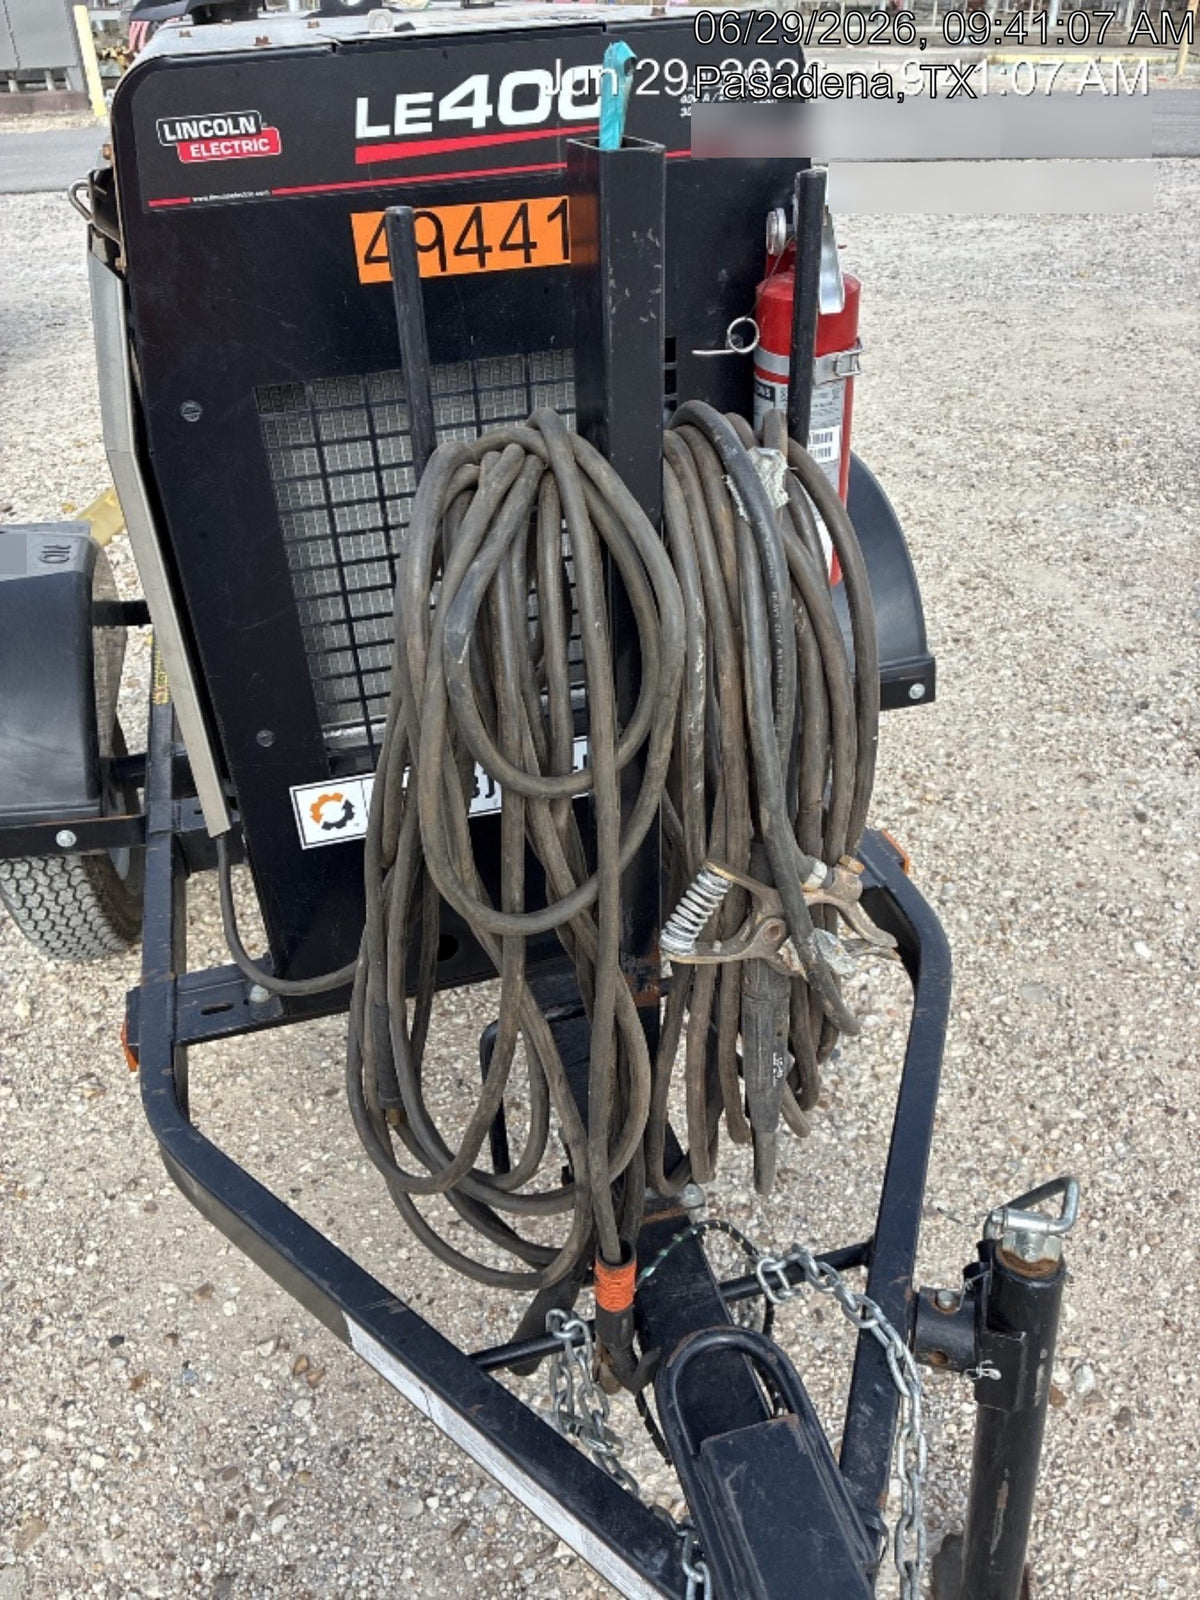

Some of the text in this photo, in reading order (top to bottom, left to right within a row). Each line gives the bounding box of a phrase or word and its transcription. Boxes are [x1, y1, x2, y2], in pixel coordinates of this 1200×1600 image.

[355, 64, 602, 139] LE400
[163, 115, 257, 141] LINCOLN
[189, 138, 271, 158] ELECTRIC
[363, 198, 570, 273] 49441
